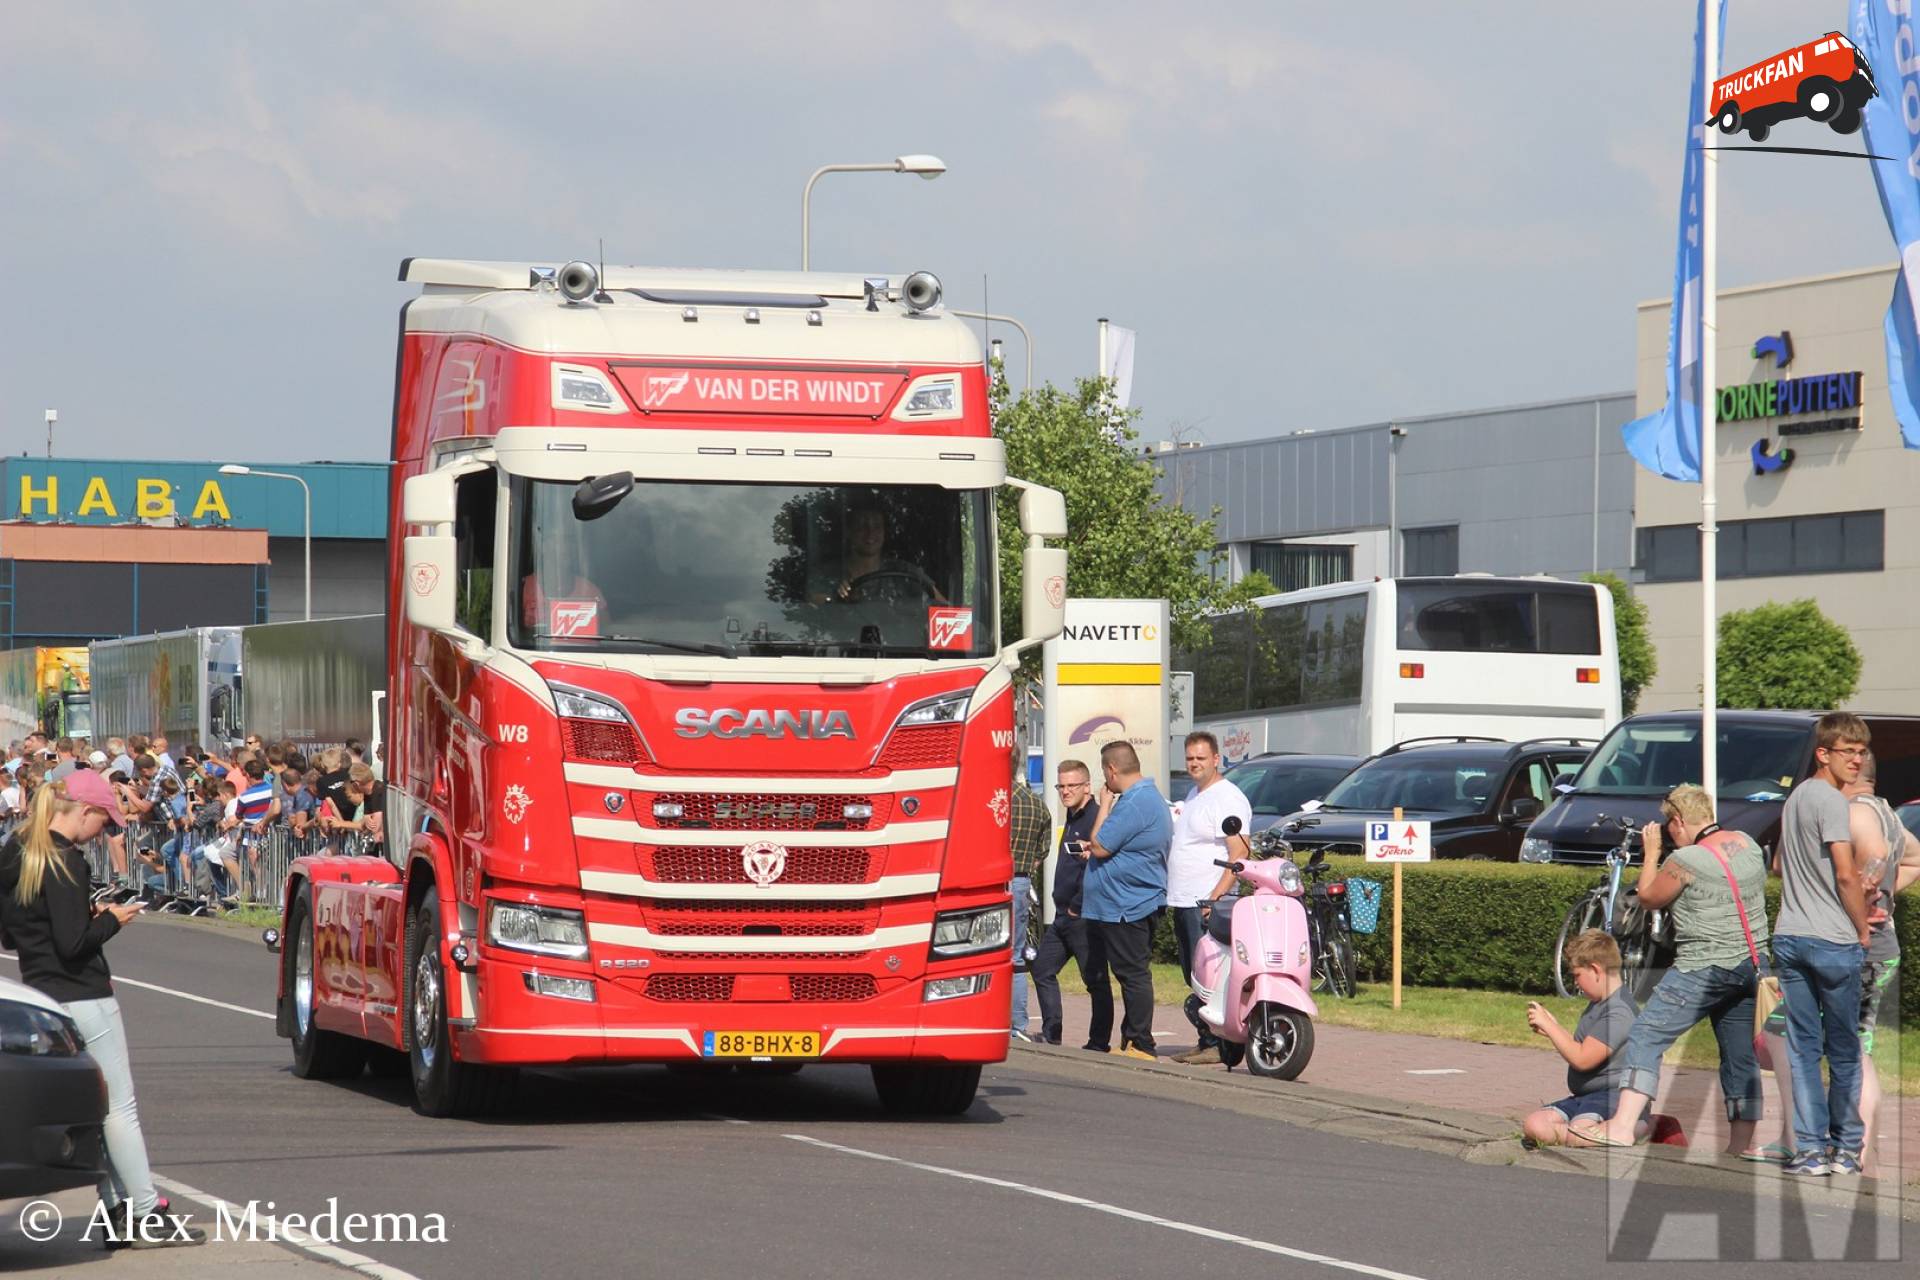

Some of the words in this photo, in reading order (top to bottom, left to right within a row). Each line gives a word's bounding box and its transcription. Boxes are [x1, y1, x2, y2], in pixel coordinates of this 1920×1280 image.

[695, 377, 743, 400] VAN
[751, 379, 800, 401] DER
[806, 380, 885, 404] WINDT
[20, 475, 231, 520] HABA
[1062, 625, 1156, 641] NAVETTO
[673, 707, 857, 740] SCANIA
[498, 724, 528, 743] W8
[991, 730, 1013, 748] W8
[714, 802, 817, 819] SUPER
[1375, 844, 1415, 858] Tekno
[600, 959, 612, 968] R
[614, 959, 650, 968] 520
[719, 1035, 813, 1053] 88-BHX-8
